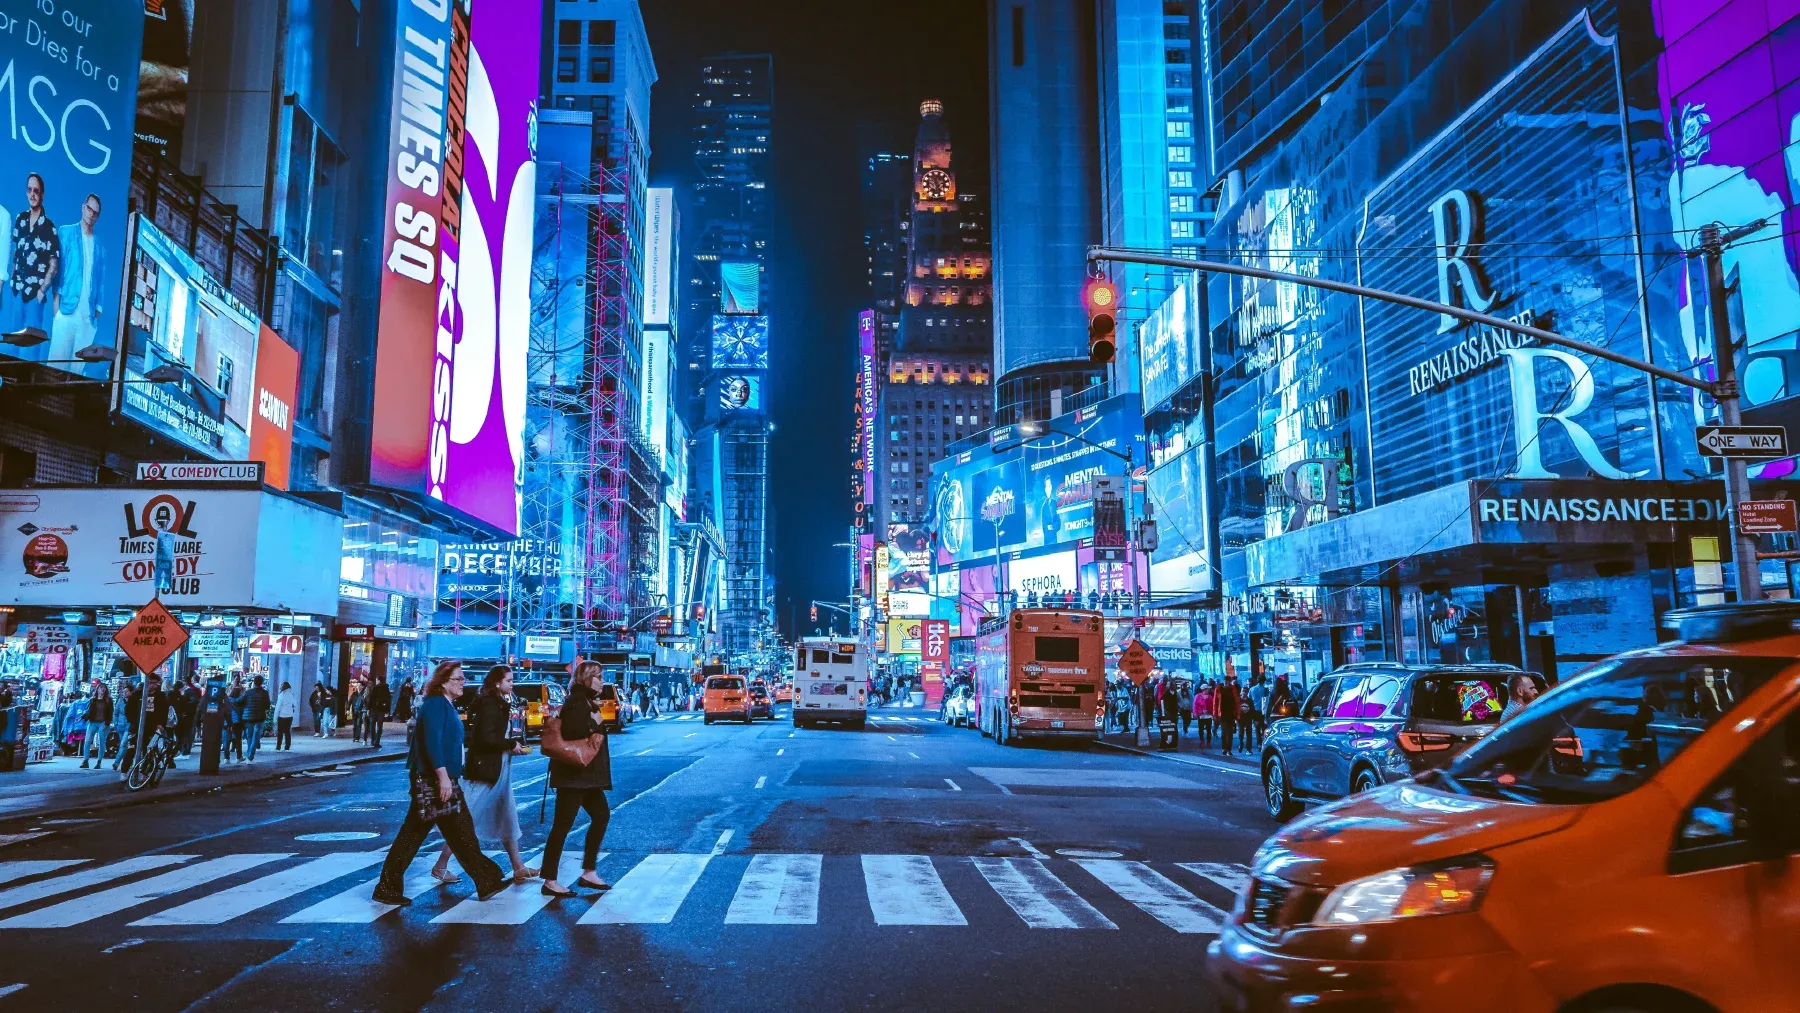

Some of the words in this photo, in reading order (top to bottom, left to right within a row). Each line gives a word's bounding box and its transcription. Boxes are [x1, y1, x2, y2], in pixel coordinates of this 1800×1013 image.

[62, 10, 92, 37] our
[26, 19, 68, 63] Dies
[76, 45, 101, 80] for
[107, 74, 119, 92] a
[396, 25, 447, 198] TIMES
[134, 132, 168, 146] verflow
[386, 201, 437, 285] SQ
[1428, 189, 1497, 335] R
[1409, 309, 1536, 397] RENAISSANCE
[430, 249, 458, 502] KISS
[863, 355, 874, 414] AMERICA'S
[854, 372, 863, 444] ERNST
[1500, 348, 1651, 480] R
[1135, 434, 1146, 442] TH
[1708, 435, 1736, 448] ONE
[1749, 436, 1778, 448] WAY
[1064, 464, 1106, 487] MENTAL
[1056, 480, 1092, 507] SAMU
[124, 494, 198, 539] LOL
[1480, 498, 1677, 522] RENAISSANCE
[1095, 534, 1125, 546] RISE
[1097, 524, 1124, 536] ALL
[119, 537, 155, 554] TIMES
[444, 552, 562, 577] DECEMBER
[1021, 574, 1062, 592] SEPHORA
[1226, 596, 1240, 616] Lids
[1248, 592, 1265, 614] Lids
[137, 626, 164, 635] WORK
[140, 615, 166, 624] ROAD
[28, 643, 39, 653] 4
[132, 637, 167, 646] AHEAD
[276, 635, 302, 653] 10
[928, 623, 945, 657] tkts
[1152, 648, 1192, 660] ktstkts
[211, 687, 219, 697] P
